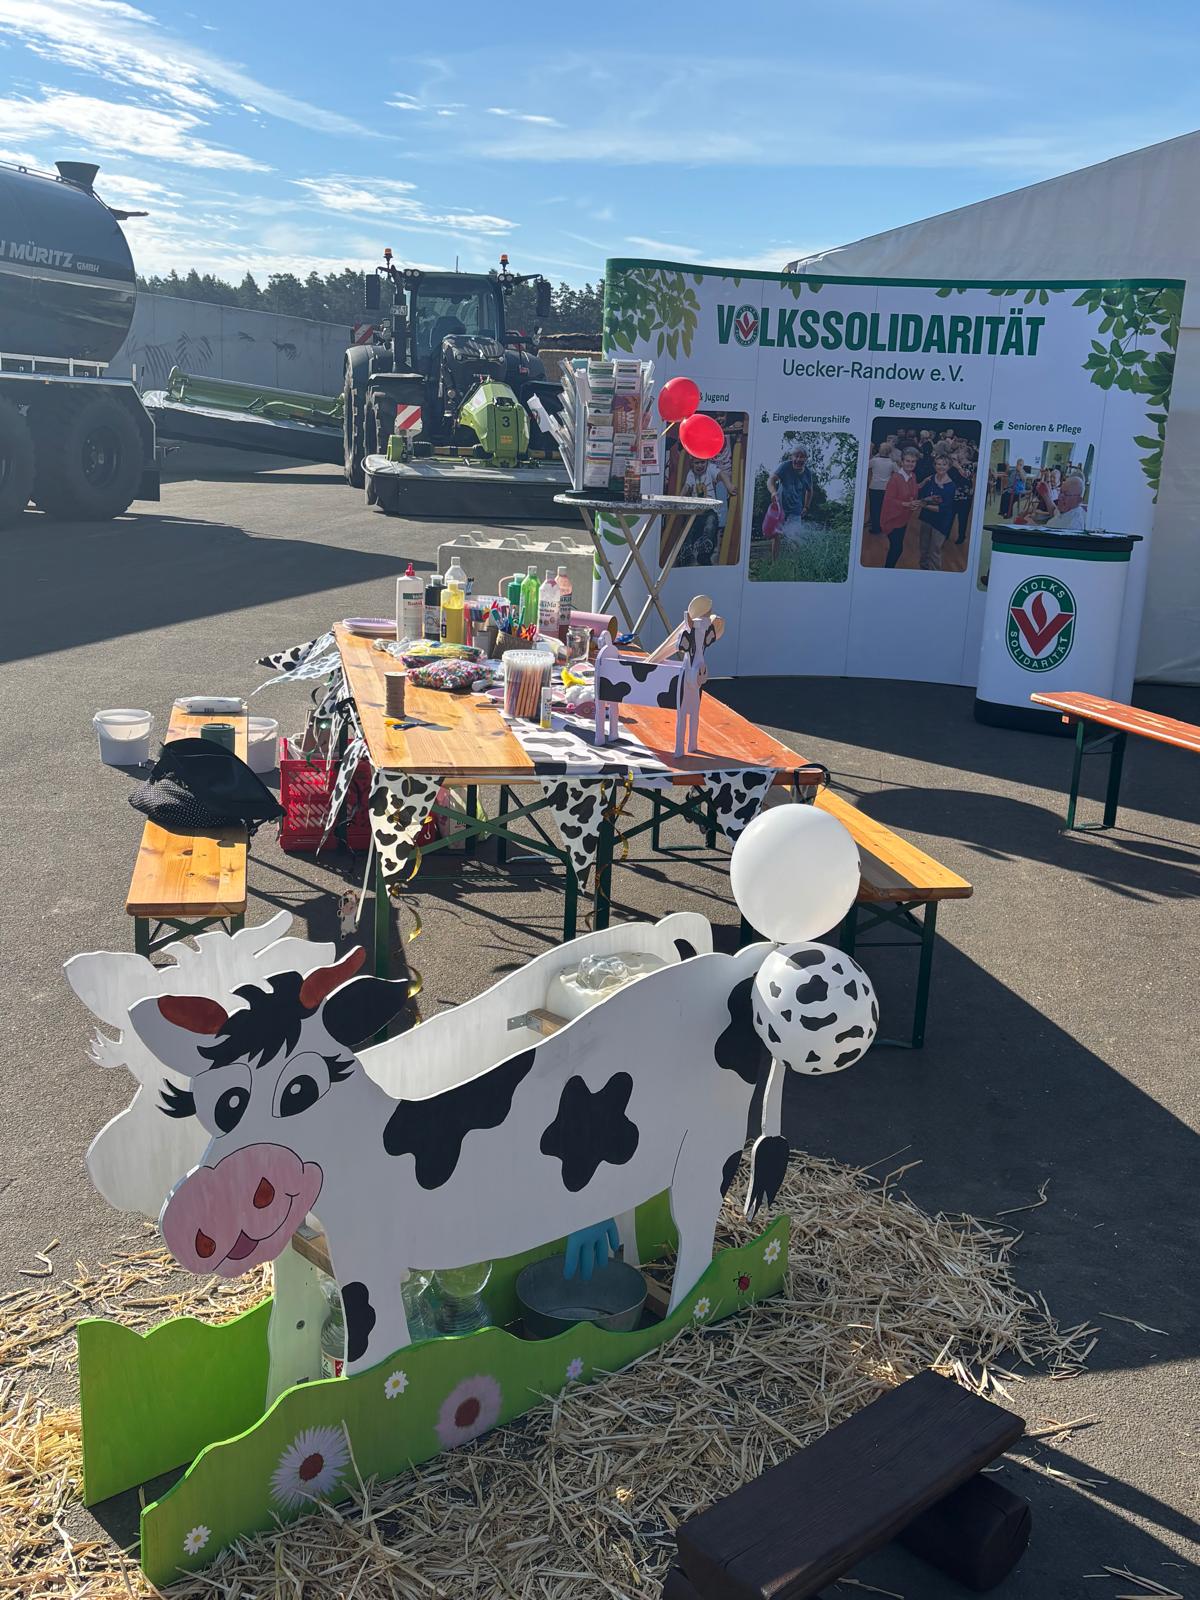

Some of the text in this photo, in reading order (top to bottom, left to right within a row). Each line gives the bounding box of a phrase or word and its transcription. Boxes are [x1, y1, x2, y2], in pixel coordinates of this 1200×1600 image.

[9, 241, 74, 268] MÜRITZ
[717, 303, 1046, 356] VOLKSSOLIDARITÄT
[783, 358, 925, 381] Uecker-Randow
[704, 392, 730, 403] Jugend
[889, 399, 977, 411] Begegnung & Kultur
[502, 416, 510, 428] 3
[772, 413, 851, 425] Eingliederungshilfe
[1008, 421, 1082, 435] Senioren & Pflege
[1022, 580, 1065, 598] VOLKS
[1010, 630, 1068, 668] SOLIDARITÄT
